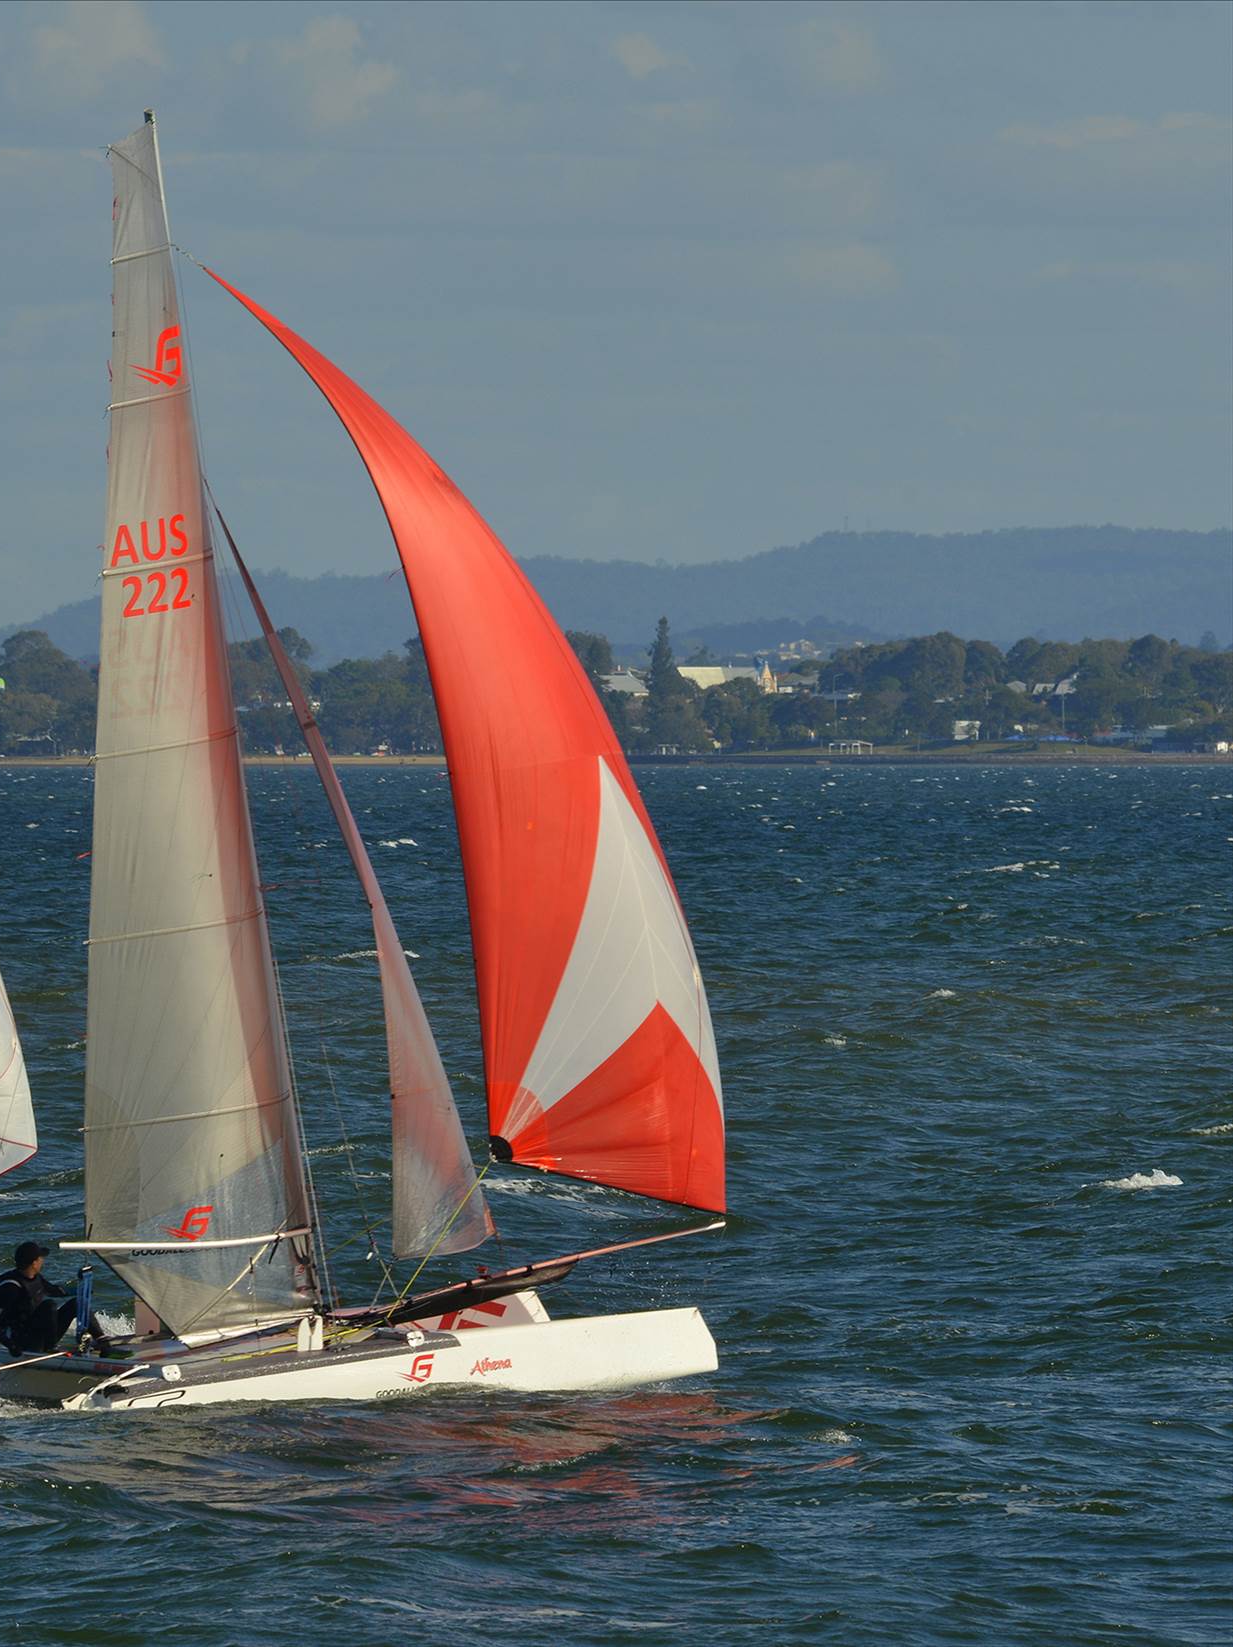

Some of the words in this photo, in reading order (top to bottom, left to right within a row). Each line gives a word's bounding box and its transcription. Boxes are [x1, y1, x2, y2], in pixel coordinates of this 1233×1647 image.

[111, 514, 189, 567] AUS
[122, 568, 192, 618] 222
[470, 1357, 512, 1376] Athena
